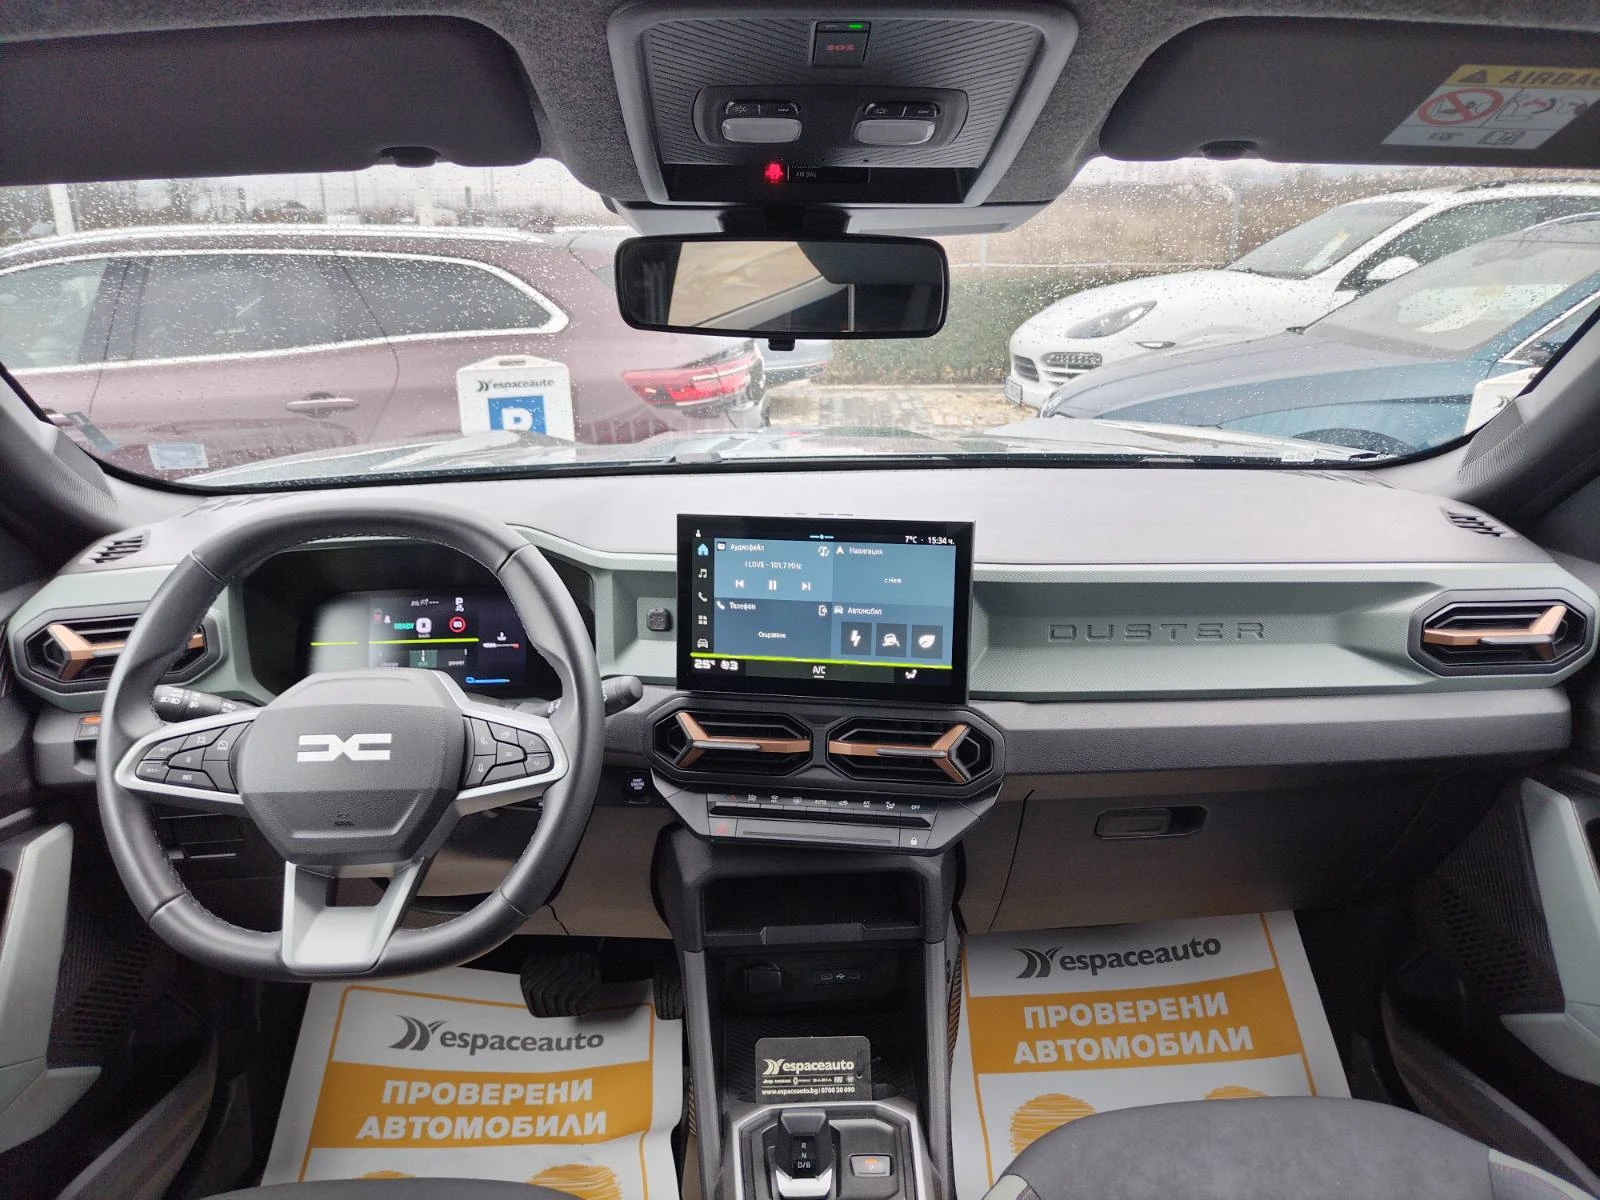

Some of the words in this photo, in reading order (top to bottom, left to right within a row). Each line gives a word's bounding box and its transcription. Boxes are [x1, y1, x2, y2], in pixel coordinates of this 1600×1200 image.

[928, 536, 947, 545] 15:34
[748, 561, 765, 569] LOVE
[730, 602, 756, 611] Телефон
[393, 622, 415, 630] READY
[1049, 622, 1265, 642] DUSTER
[812, 665, 827, 675] A/C
[1059, 935, 1222, 975] espaceauto
[1023, 991, 1229, 1029] ПРОВЕРЕНИ
[439, 1031, 605, 1056] espaceauto
[1013, 1025, 1254, 1065] АВТОМОБИЛИ
[782, 1060, 855, 1075] espaceauto
[382, 1078, 593, 1105] ПРОВЕРЕНИ
[356, 1111, 607, 1141] АВТОМОБИЛИ
[801, 1142, 807, 1150] R
